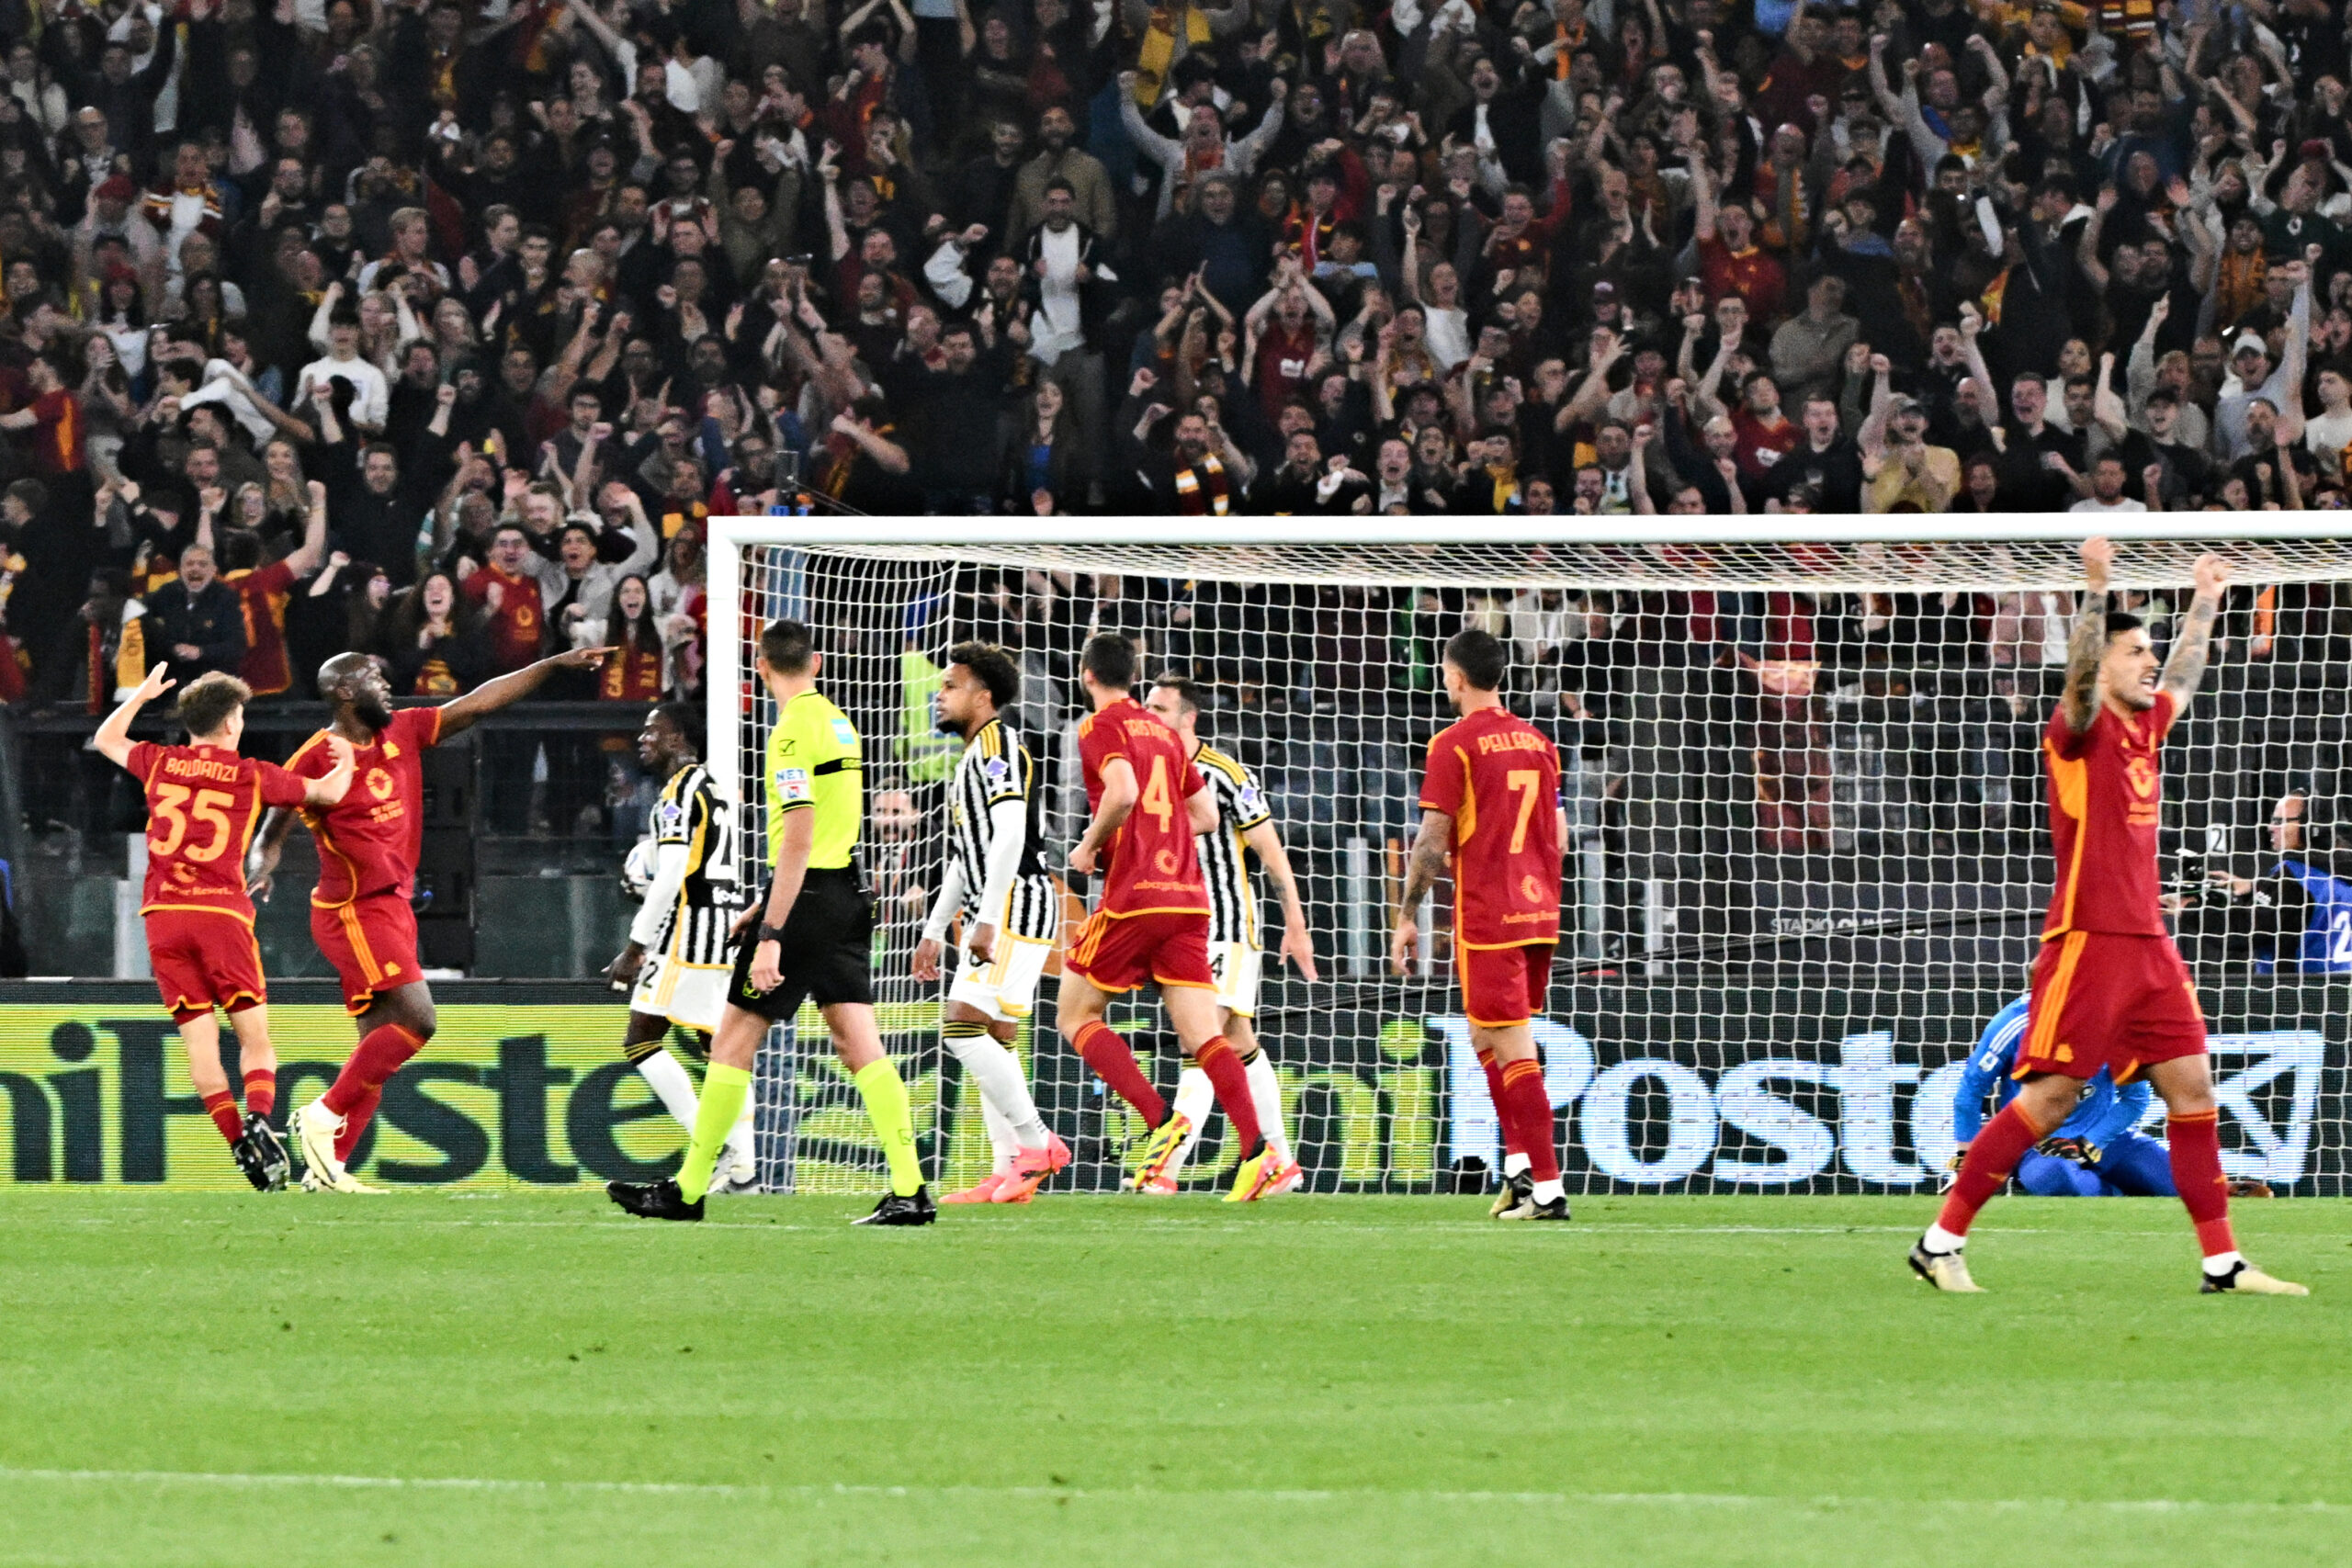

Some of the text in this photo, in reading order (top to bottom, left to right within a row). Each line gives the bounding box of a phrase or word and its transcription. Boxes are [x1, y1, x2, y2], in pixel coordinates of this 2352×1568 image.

[164, 758, 240, 782] BALDANZI
[776, 769, 804, 782] NET
[1142, 755, 1173, 832] 4
[148, 783, 235, 863] 35
[1507, 770, 1541, 853] 7
[2211, 828, 2223, 852] 2
[1770, 918, 1836, 933] STADIO
